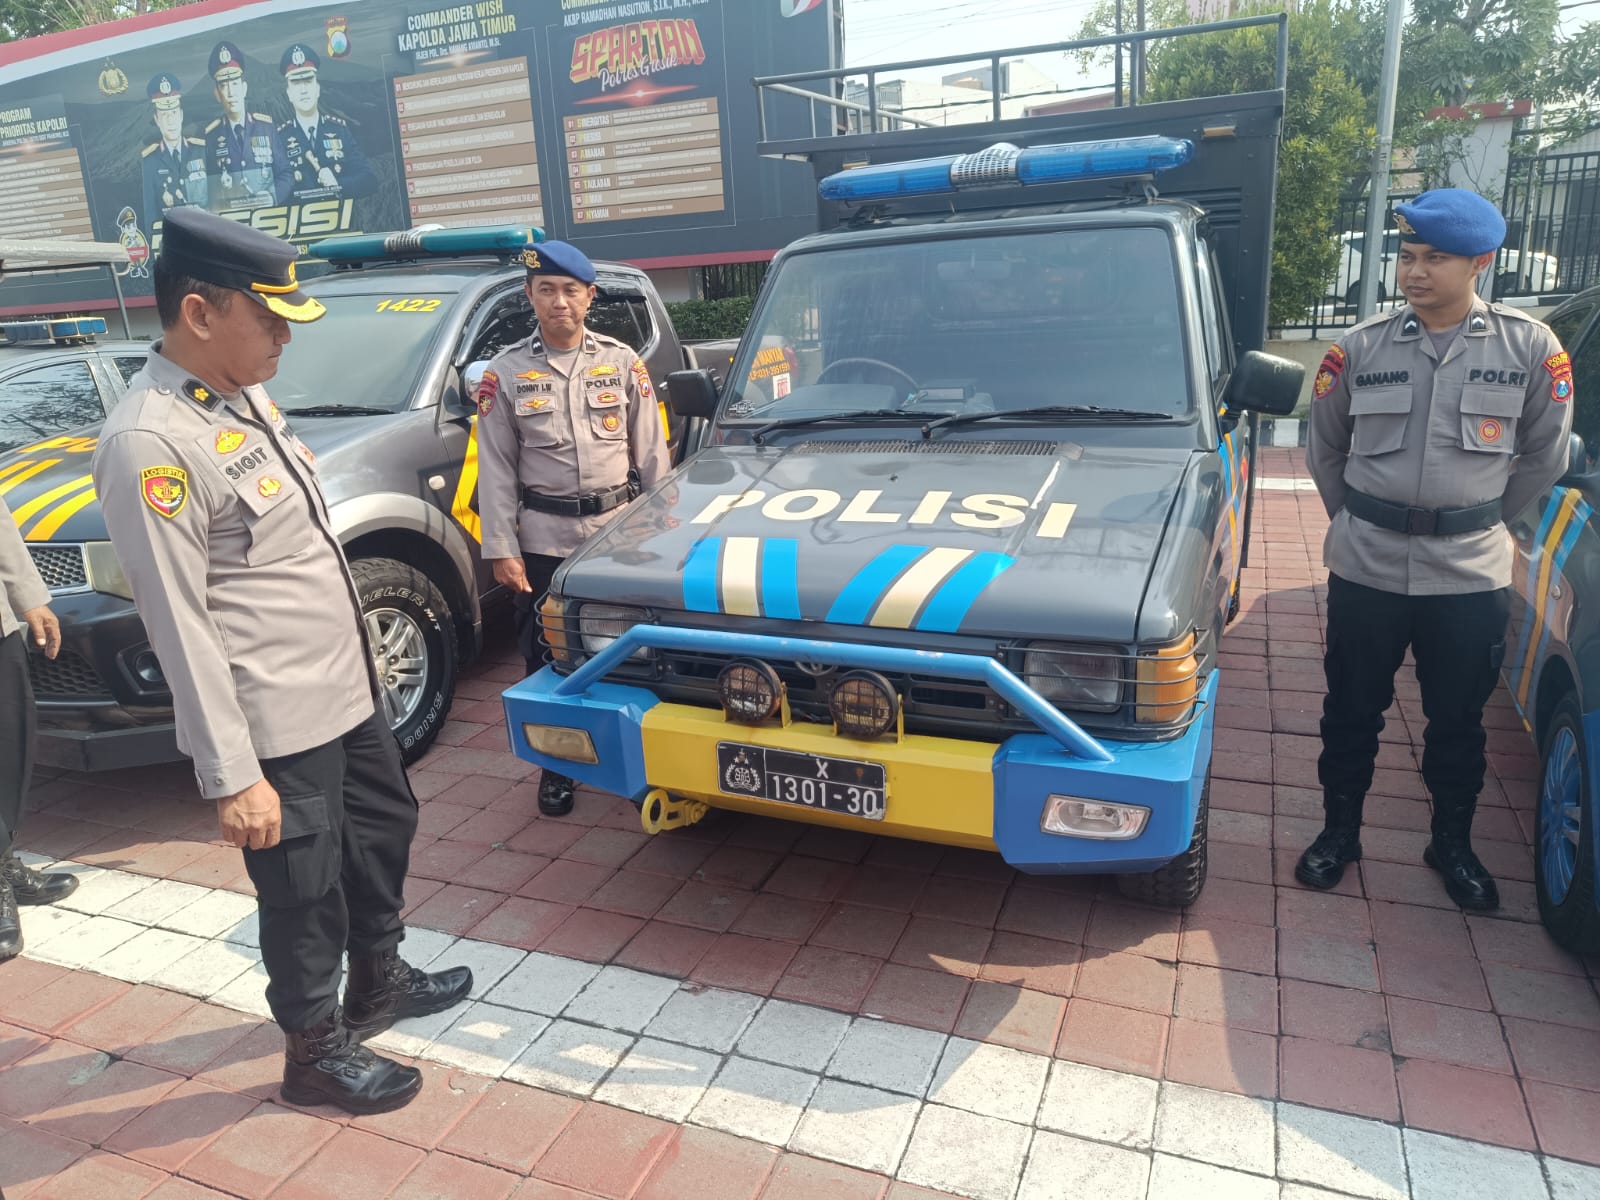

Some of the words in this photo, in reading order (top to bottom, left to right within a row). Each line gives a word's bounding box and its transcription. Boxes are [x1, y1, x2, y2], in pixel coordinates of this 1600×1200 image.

[408, 5, 474, 31] COMMANDER
[476, 0, 504, 18] WISH
[564, 13, 579, 27] AKBP
[581, 7, 617, 23] RAMADHAN
[398, 28, 446, 52] KAPOLDA
[448, 22, 478, 43] JAWA
[480, 15, 516, 37] TIMUR
[570, 19, 706, 84] SPARTAN
[597, 67, 639, 92] Polres
[638, 54, 678, 77] Gresik
[0, 122, 36, 139] PRIORITAS
[36, 116, 68, 133] KAPOLRI
[376, 299, 442, 313] 1422
[516, 383, 540, 394] DONNY
[586, 377, 622, 389] POLRI
[1355, 370, 1409, 387] GANANG
[1470, 369, 1527, 386] POLRI
[225, 446, 268, 480] SIGIT
[689, 488, 1078, 538] POLISI
[816, 758, 829, 779] X
[773, 775, 878, 817] 1301-30
